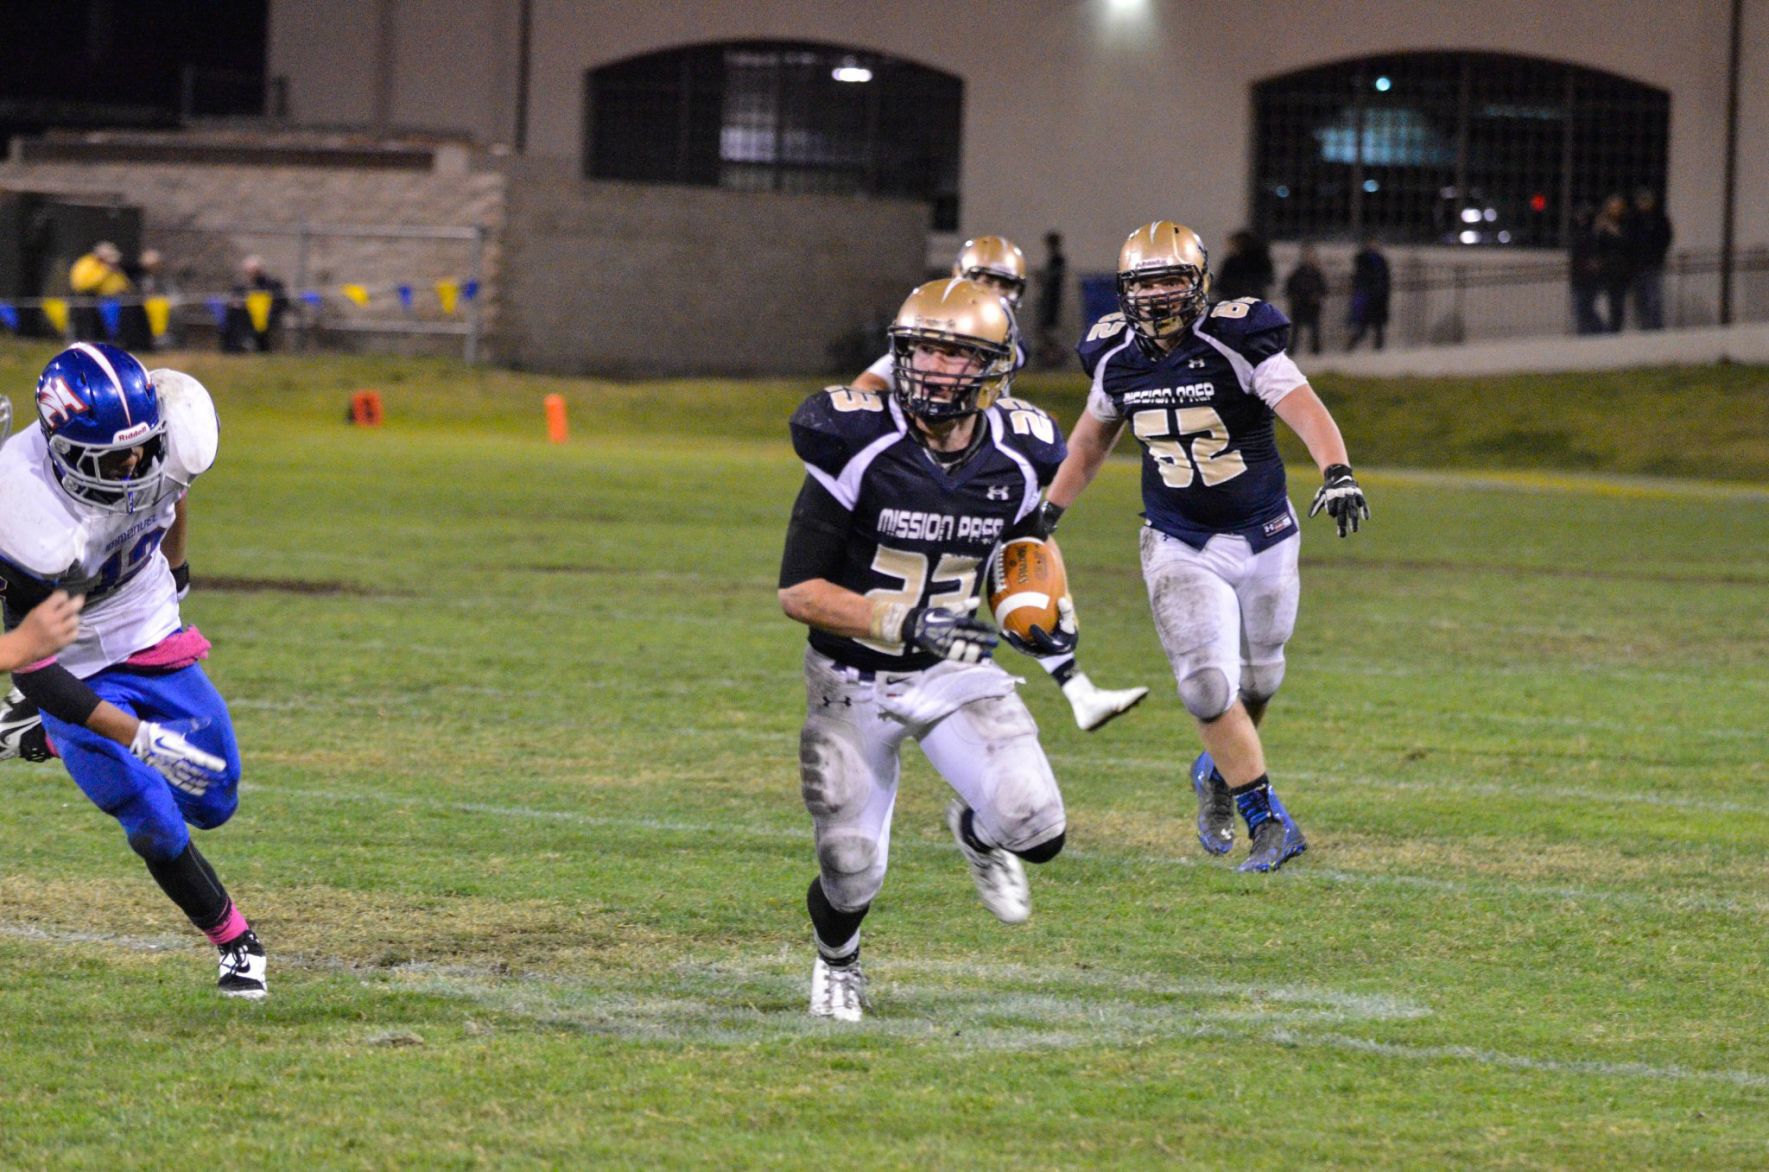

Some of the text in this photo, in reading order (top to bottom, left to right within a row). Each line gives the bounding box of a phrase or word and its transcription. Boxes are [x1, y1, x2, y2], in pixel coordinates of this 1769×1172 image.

[118, 426, 147, 442] Riddell
[1133, 406, 1247, 488] 52
[877, 508, 954, 541] MISSION
